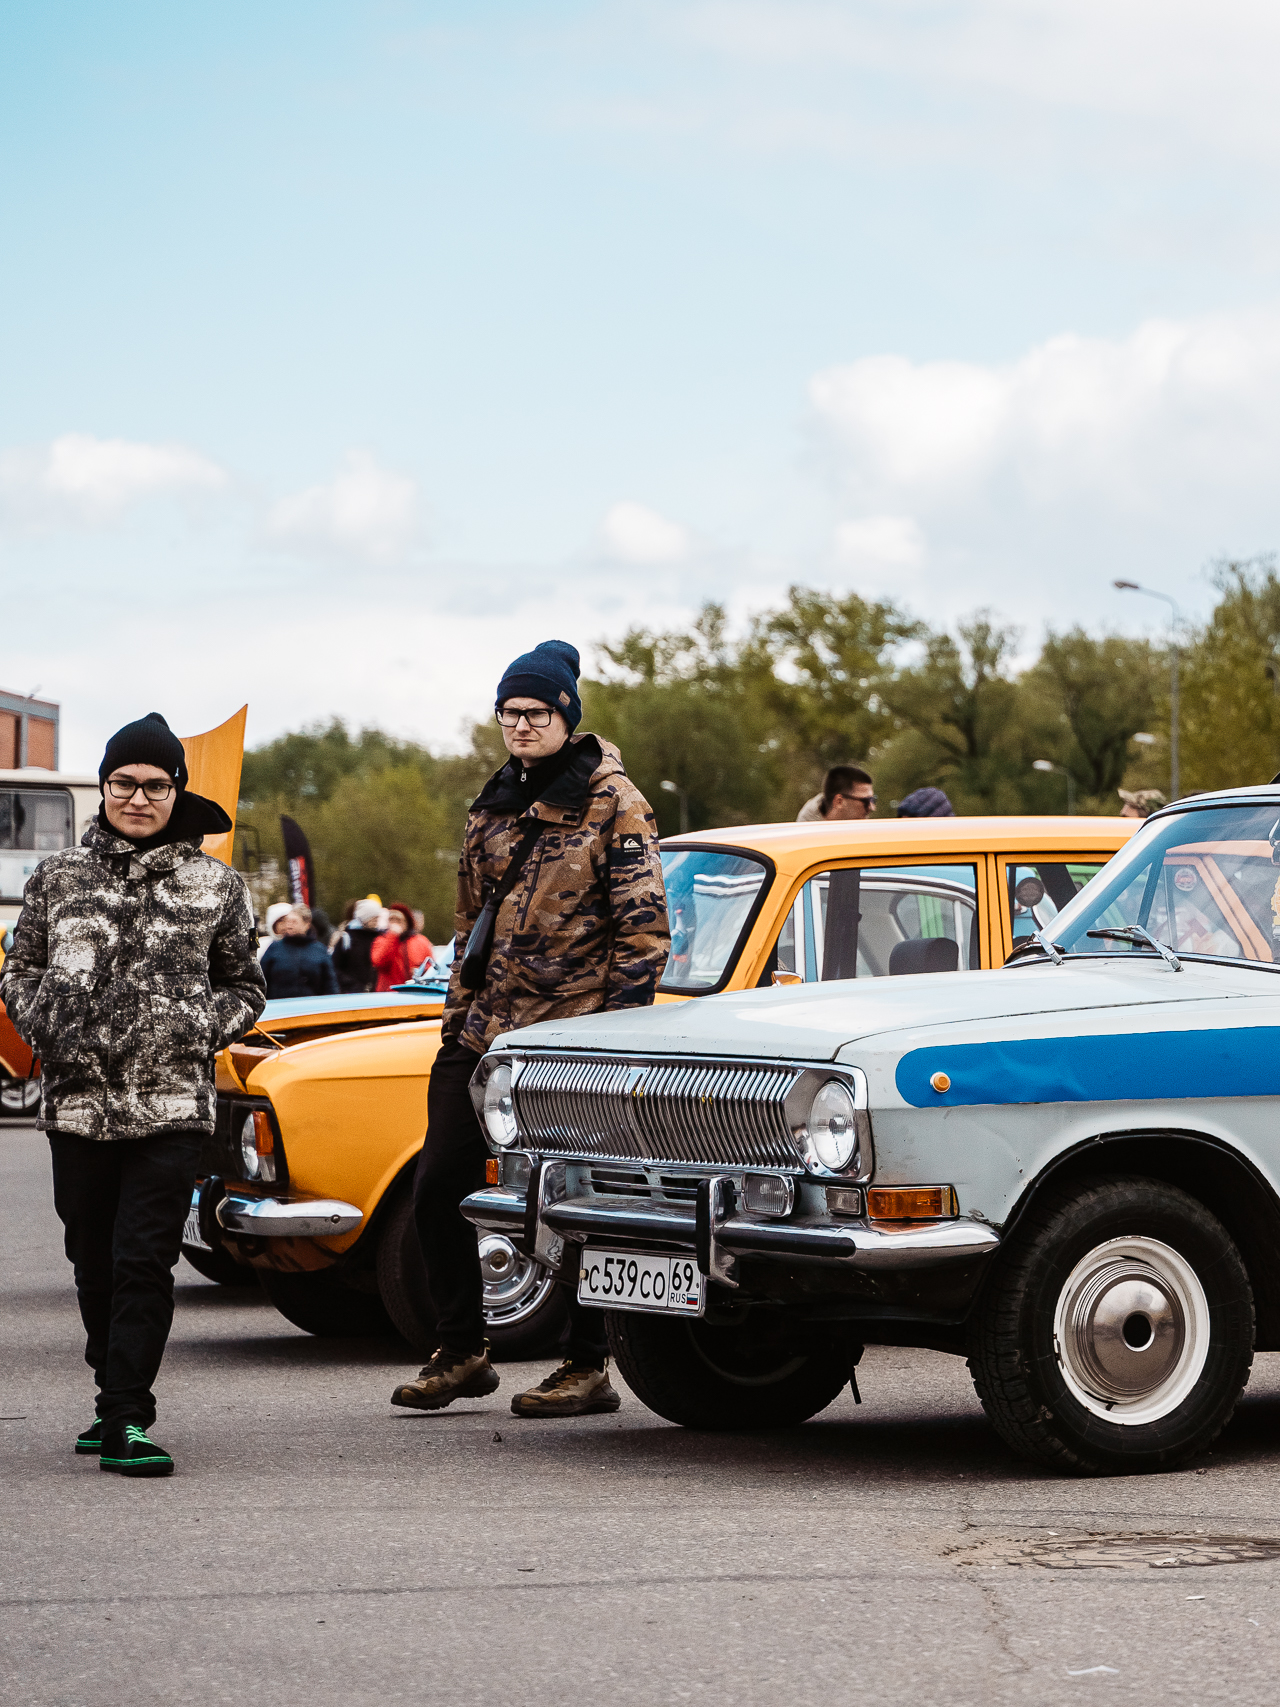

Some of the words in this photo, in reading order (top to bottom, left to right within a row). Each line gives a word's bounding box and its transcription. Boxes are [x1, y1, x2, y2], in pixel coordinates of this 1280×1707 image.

[589, 1257, 666, 1300] С539СО
[671, 1261, 694, 1292] 69
[670, 1292, 687, 1304] RUS
